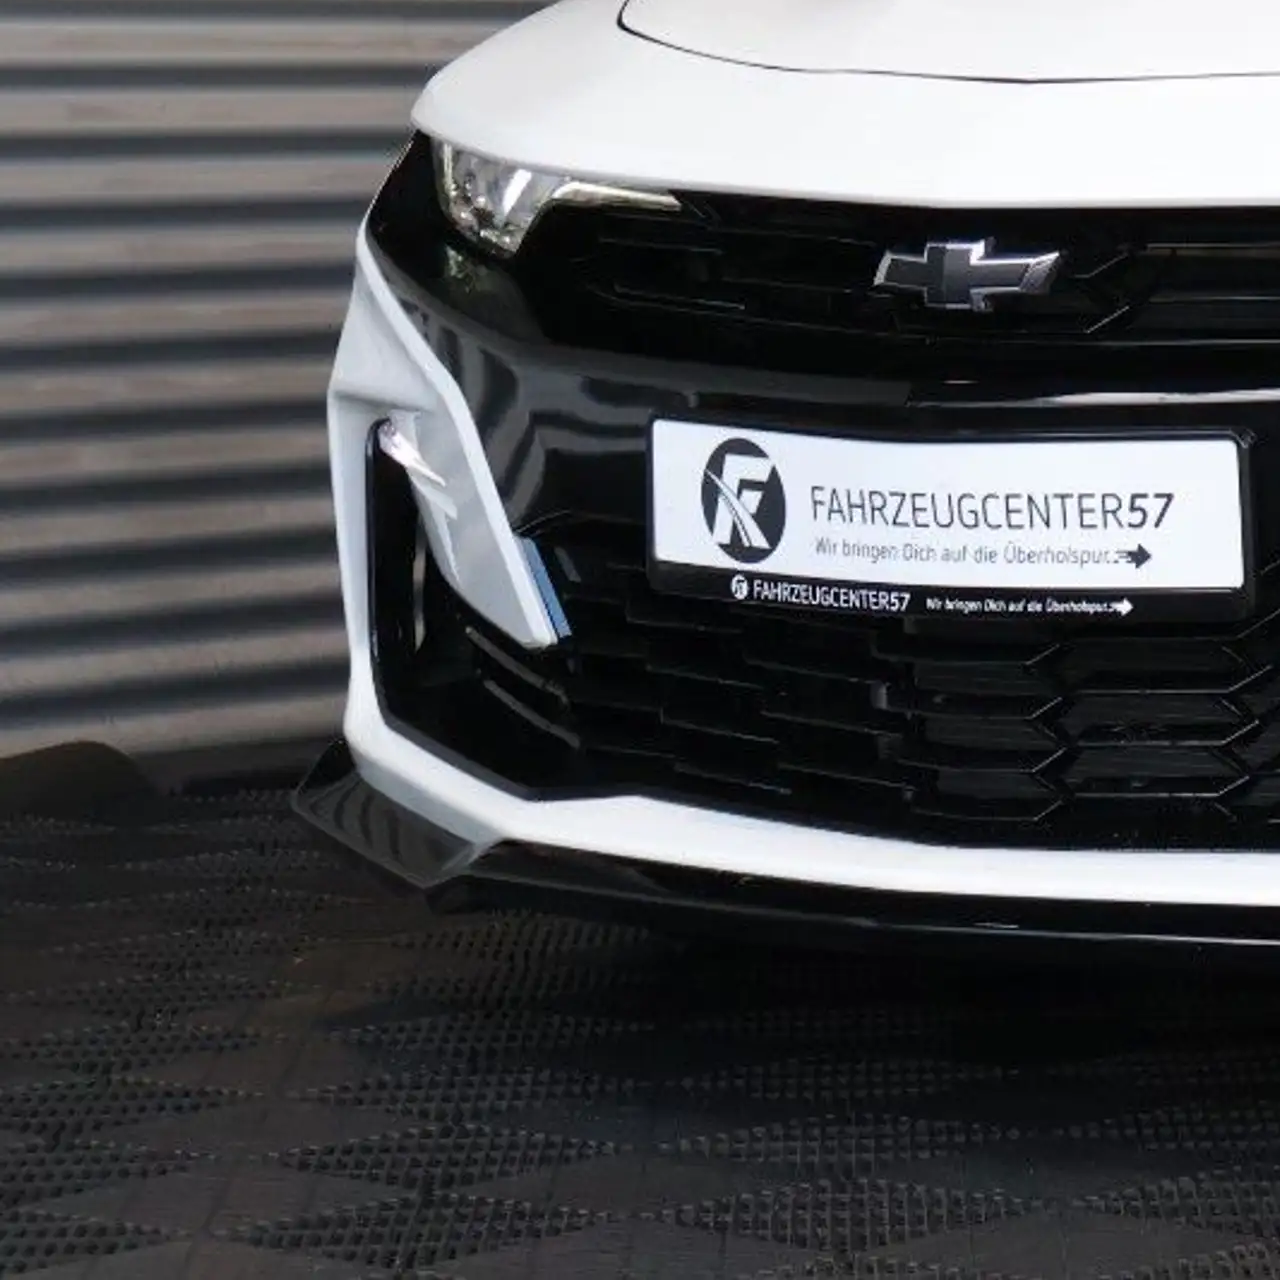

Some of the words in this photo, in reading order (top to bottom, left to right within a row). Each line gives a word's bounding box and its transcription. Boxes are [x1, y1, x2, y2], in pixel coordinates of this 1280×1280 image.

[810, 485, 1175, 531] FAHRZEUGCENTER57
[815, 536, 838, 555] Wir
[842, 538, 899, 564] bringen
[902, 542, 936, 563] Dich
[941, 545, 969, 563] auf
[974, 545, 998, 564] die
[752, 579, 911, 612] FAHRZEUGCENTER57
